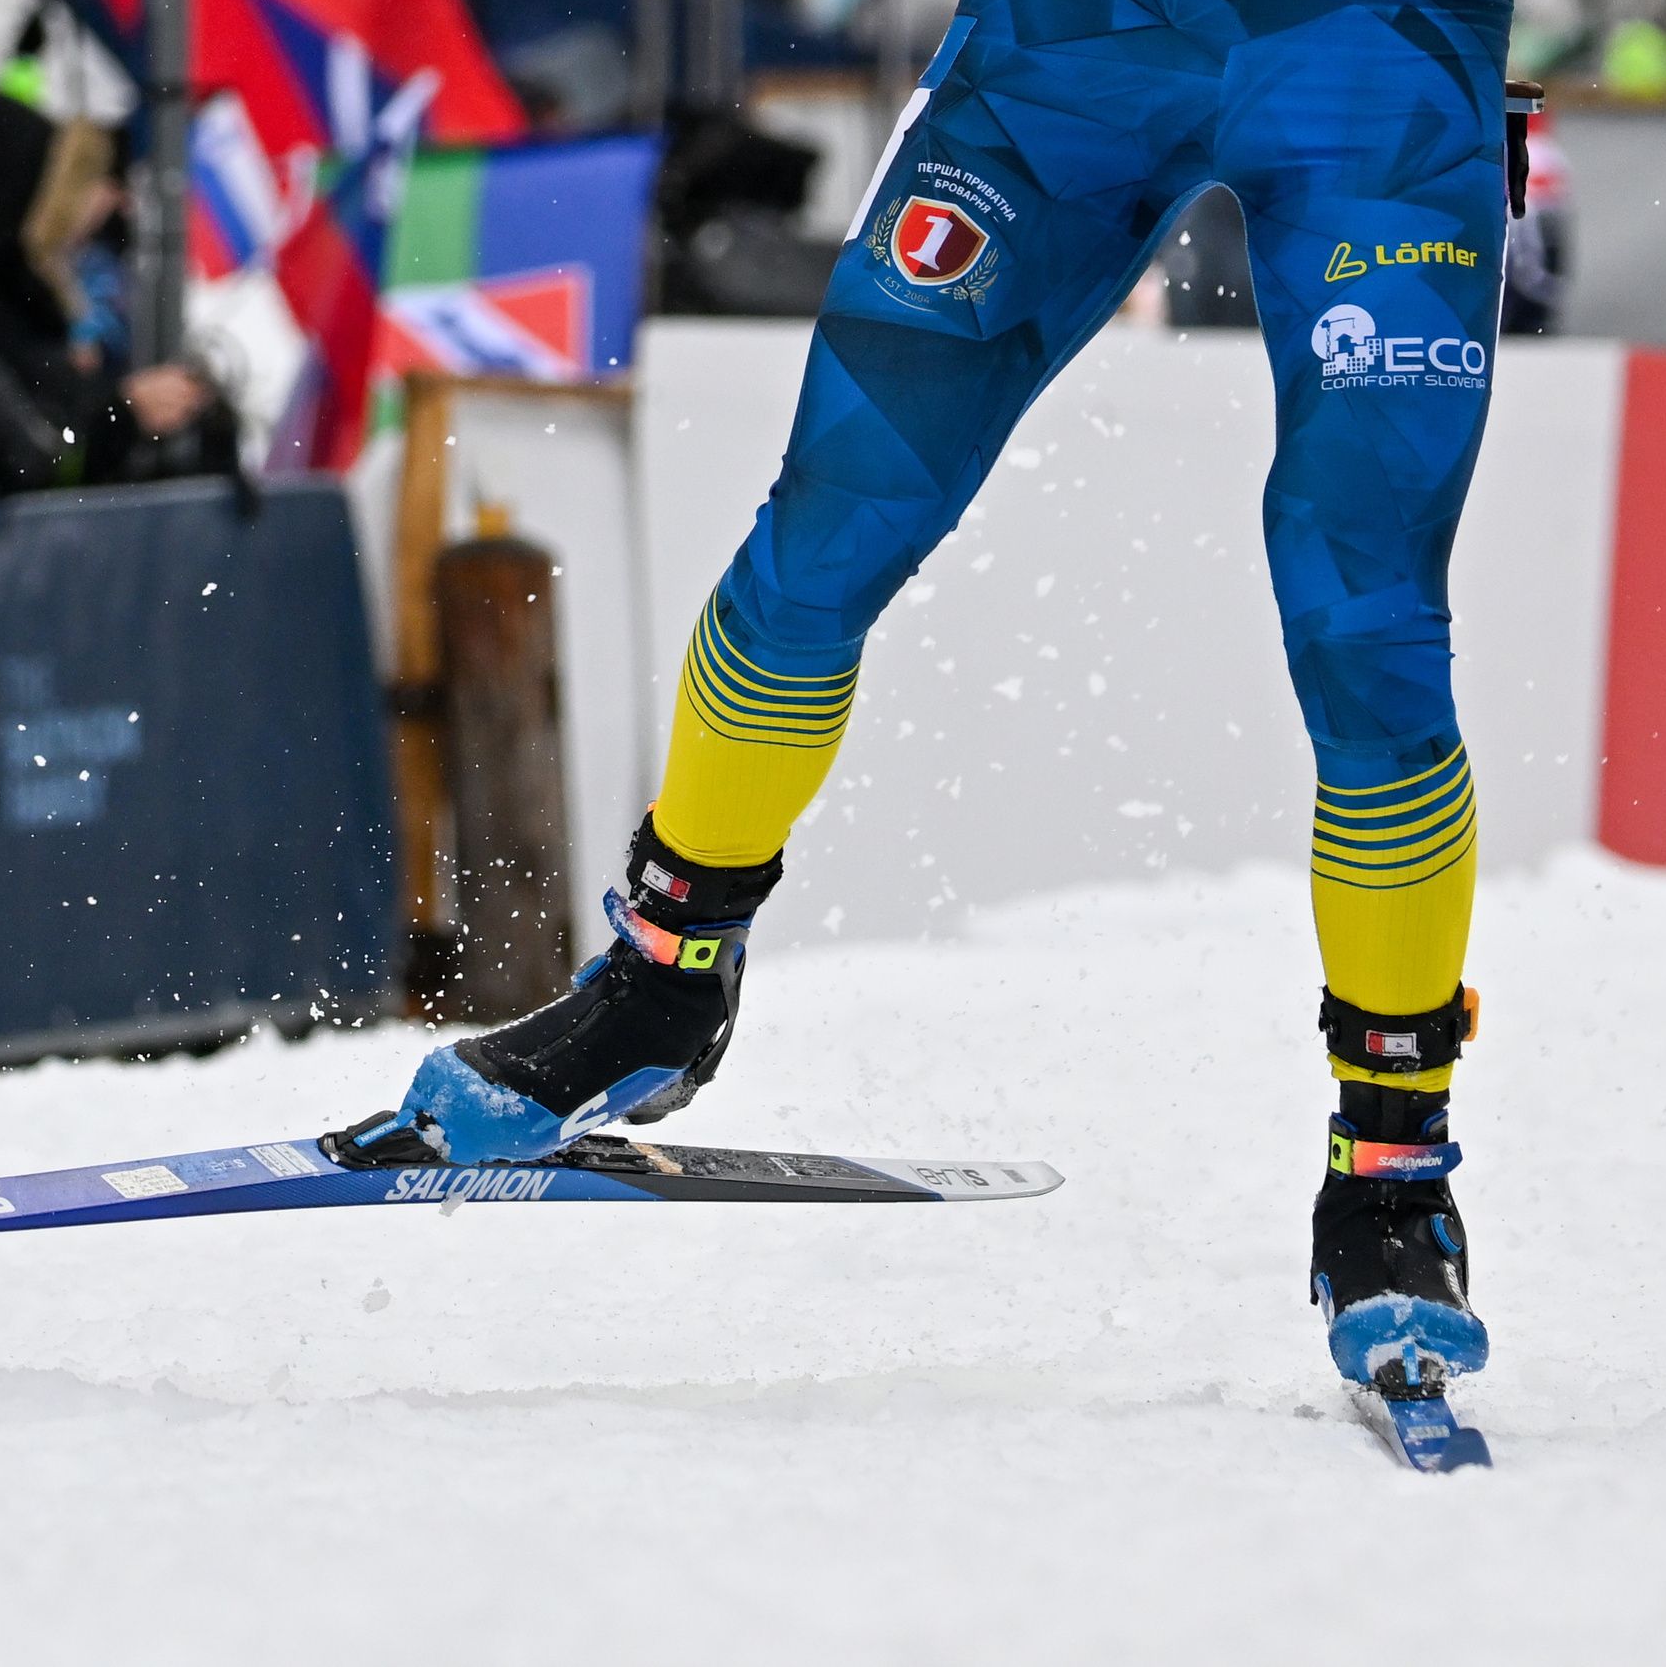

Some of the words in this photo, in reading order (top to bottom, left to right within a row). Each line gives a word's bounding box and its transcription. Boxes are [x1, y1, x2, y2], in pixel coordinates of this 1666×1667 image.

[917, 161, 962, 180] ПЕРША
[961, 171, 1017, 223] ПРИВАТНА
[933, 177, 992, 215] БРОВАРНЯ
[906, 214, 954, 272] 1
[884, 276, 902, 293] EST
[1383, 337, 1486, 375] ECO
[1320, 374, 1420, 391] COMFORT
[1424, 374, 1486, 390] SLOVENIA
[384, 1168, 558, 1202] SALOMON
